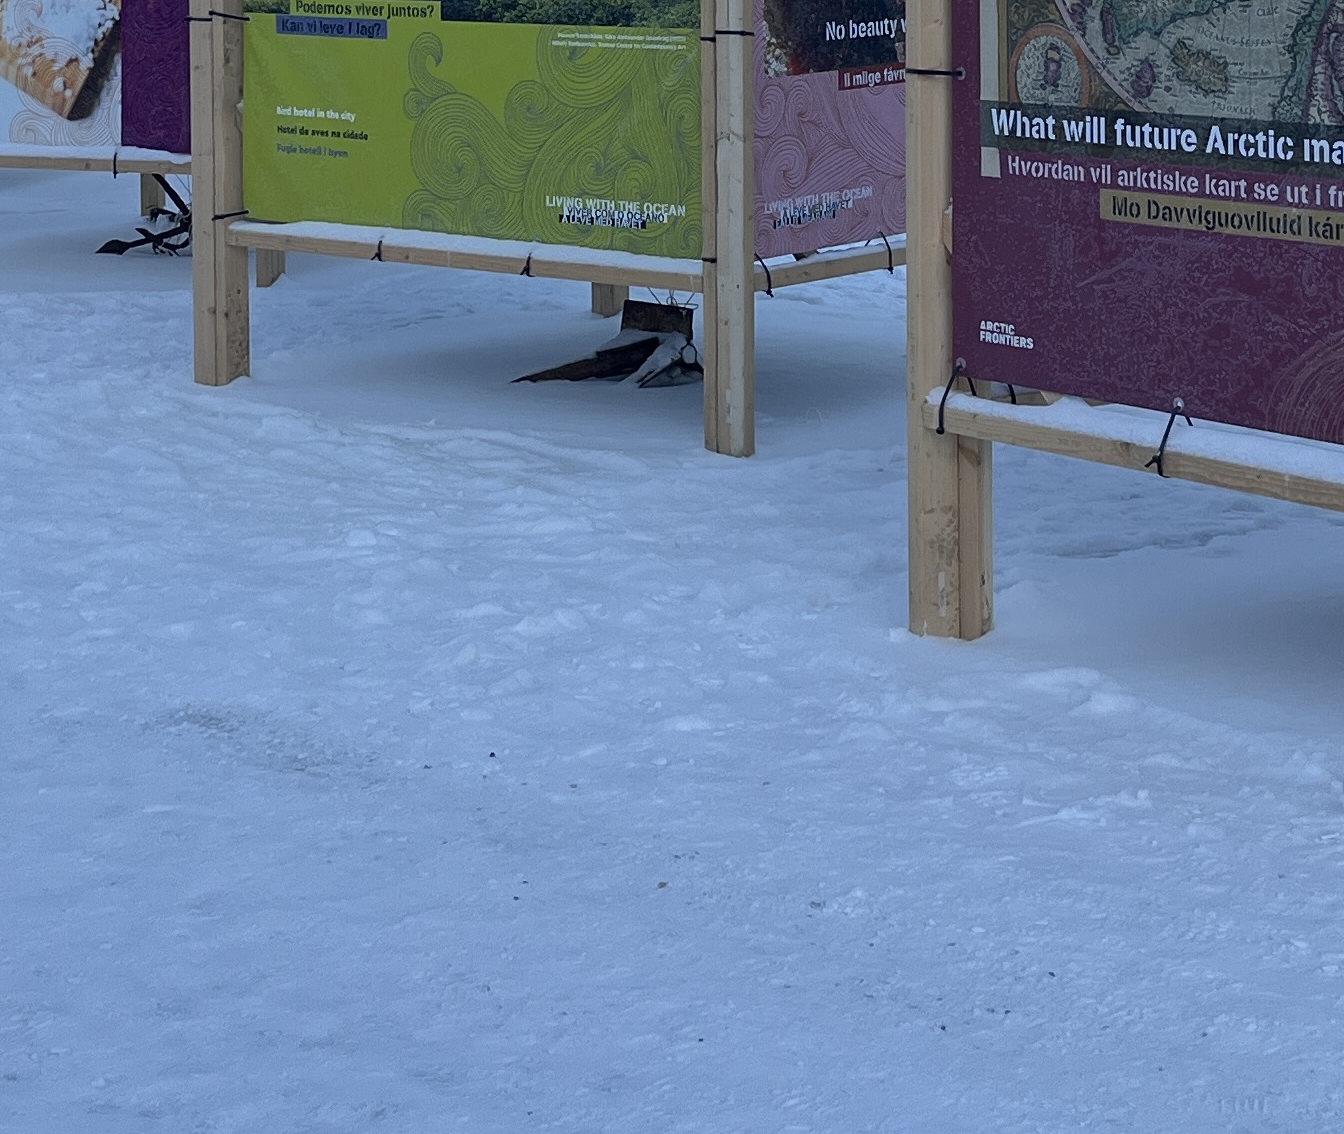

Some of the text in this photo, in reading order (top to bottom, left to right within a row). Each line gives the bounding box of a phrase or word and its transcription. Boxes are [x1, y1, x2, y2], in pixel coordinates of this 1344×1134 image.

[295, 0, 434, 19] Podemos viver juntos?
[281, 18, 303, 32] Kan
[307, 20, 316, 33] vi
[319, 20, 344, 35] leve
[356, 22, 381, 39] lag?
[825, 20, 845, 41] No
[849, 17, 897, 39] beauty
[293, 107, 315, 117] hotel
[316, 107, 325, 118] in
[326, 108, 339, 120] the
[341, 110, 356, 123] city
[276, 125, 369, 141] Hotel cidade
[991, 108, 1056, 140] What
[1062, 115, 1106, 145] will
[1114, 118, 1197, 153] future
[1206, 124, 1294, 161] Arctic
[1007, 154, 1085, 182] Hvordan
[1090, 164, 1112, 185] vil
[1117, 167, 1200, 194] arktiske
[1205, 173, 1247, 198] kart
[1253, 181, 1280, 202] se
[1286, 183, 1308, 205] ut
[1315, 184, 1321, 205] i
[1112, 195, 1141, 218] Mo
[1147, 199, 1302, 237] Davviguovlluid
[980, 320, 1015, 335] ARCTIC
[979, 330, 1034, 349] FRONTIERS
